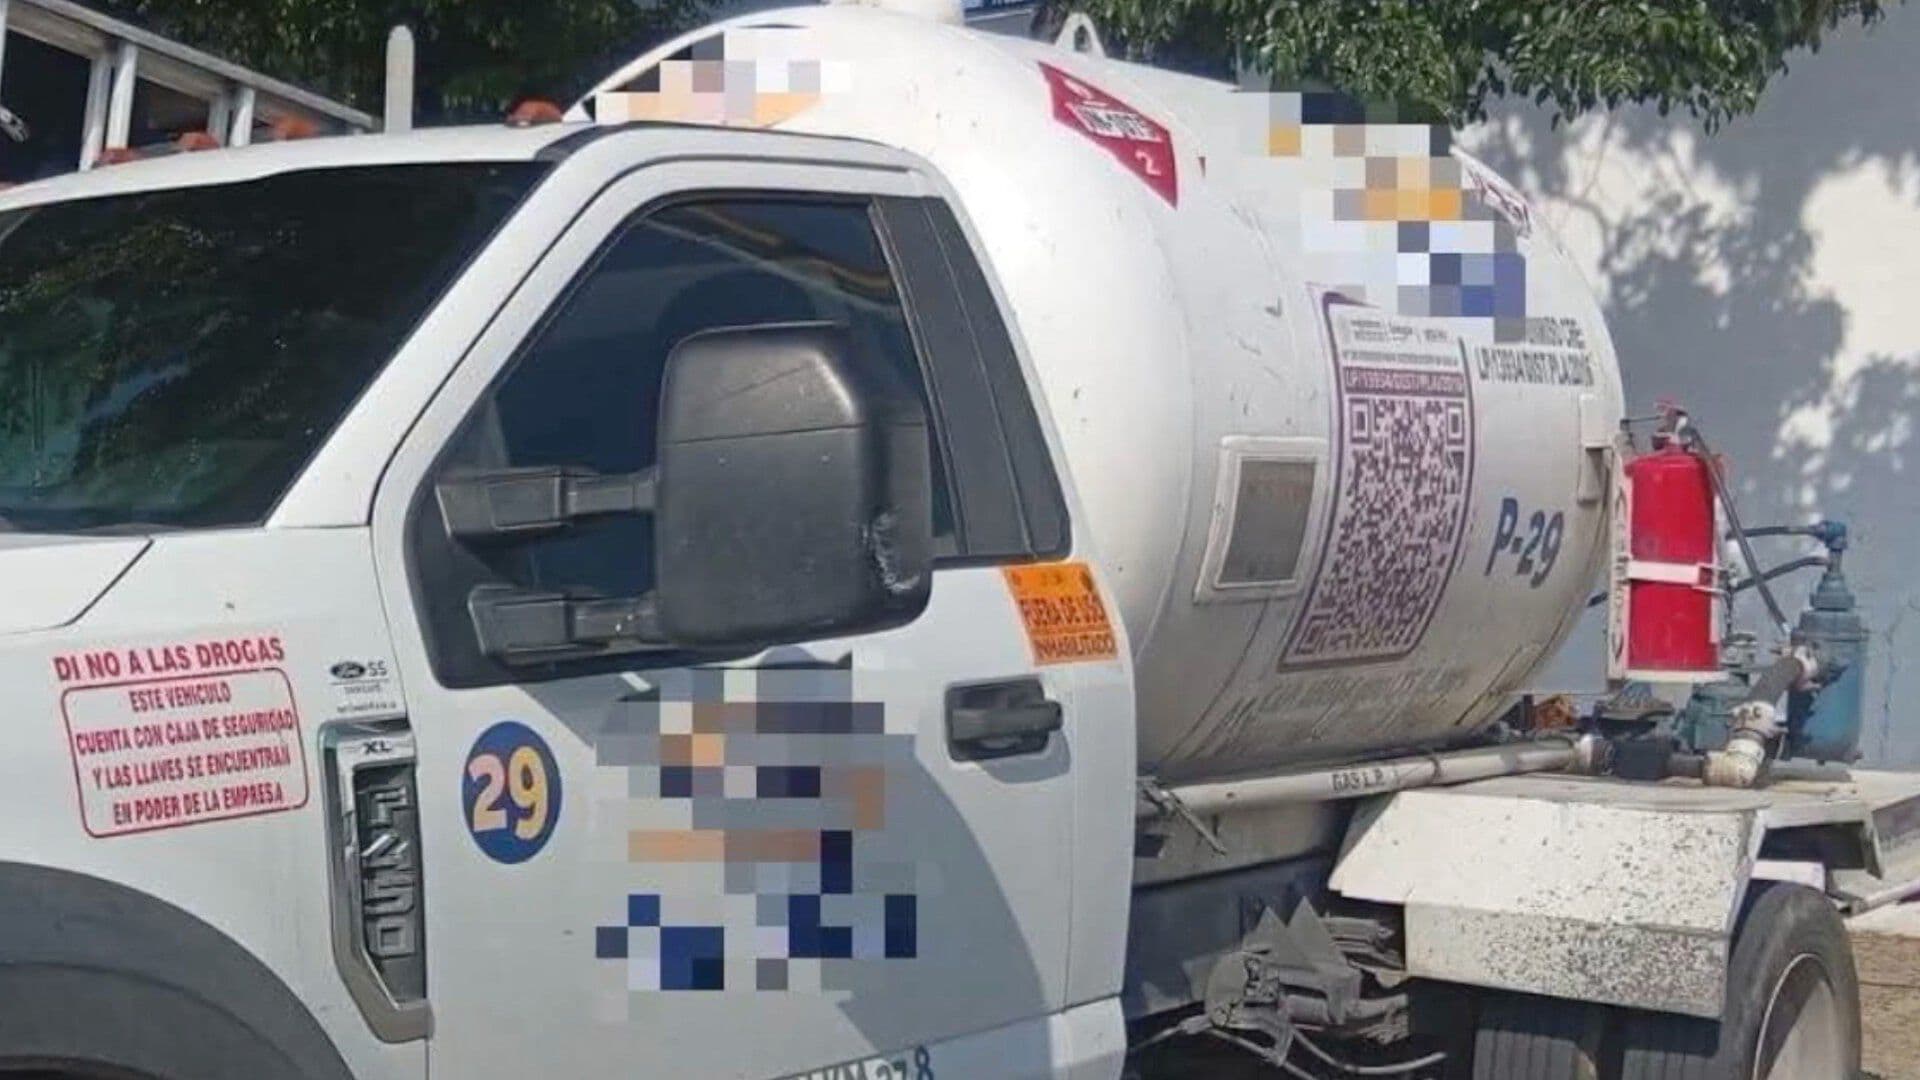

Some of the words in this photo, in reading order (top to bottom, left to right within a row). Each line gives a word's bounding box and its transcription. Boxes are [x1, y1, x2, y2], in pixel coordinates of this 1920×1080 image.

[1135, 148, 1162, 175] 2
[1483, 497, 1565, 590] P-29
[53, 655, 81, 681] DI
[84, 651, 121, 679] NO
[128, 650, 145, 675] A
[146, 645, 192, 673] LAS
[195, 637, 285, 669] DROGAS
[129, 688, 165, 713] ESTE
[76, 728, 133, 755] CUENTA
[133, 724, 164, 749] CON
[165, 719, 201, 746] CAJA
[202, 717, 222, 741] DE
[222, 709, 294, 738] SEGURIDAD
[362, 740, 393, 755] XL
[92, 766, 103, 791] Y
[105, 763, 134, 788] LAS
[134, 757, 184, 786] LLAVES
[186, 755, 205, 779] SE
[206, 745, 291, 776] ENCUENTRAN
[113, 802, 133, 826] EN
[134, 795, 181, 822] PODER
[182, 792, 202, 815] DE
[202, 789, 221, 812] LA
[222, 782, 284, 810] EMPRESA
[467, 744, 550, 842] 29
